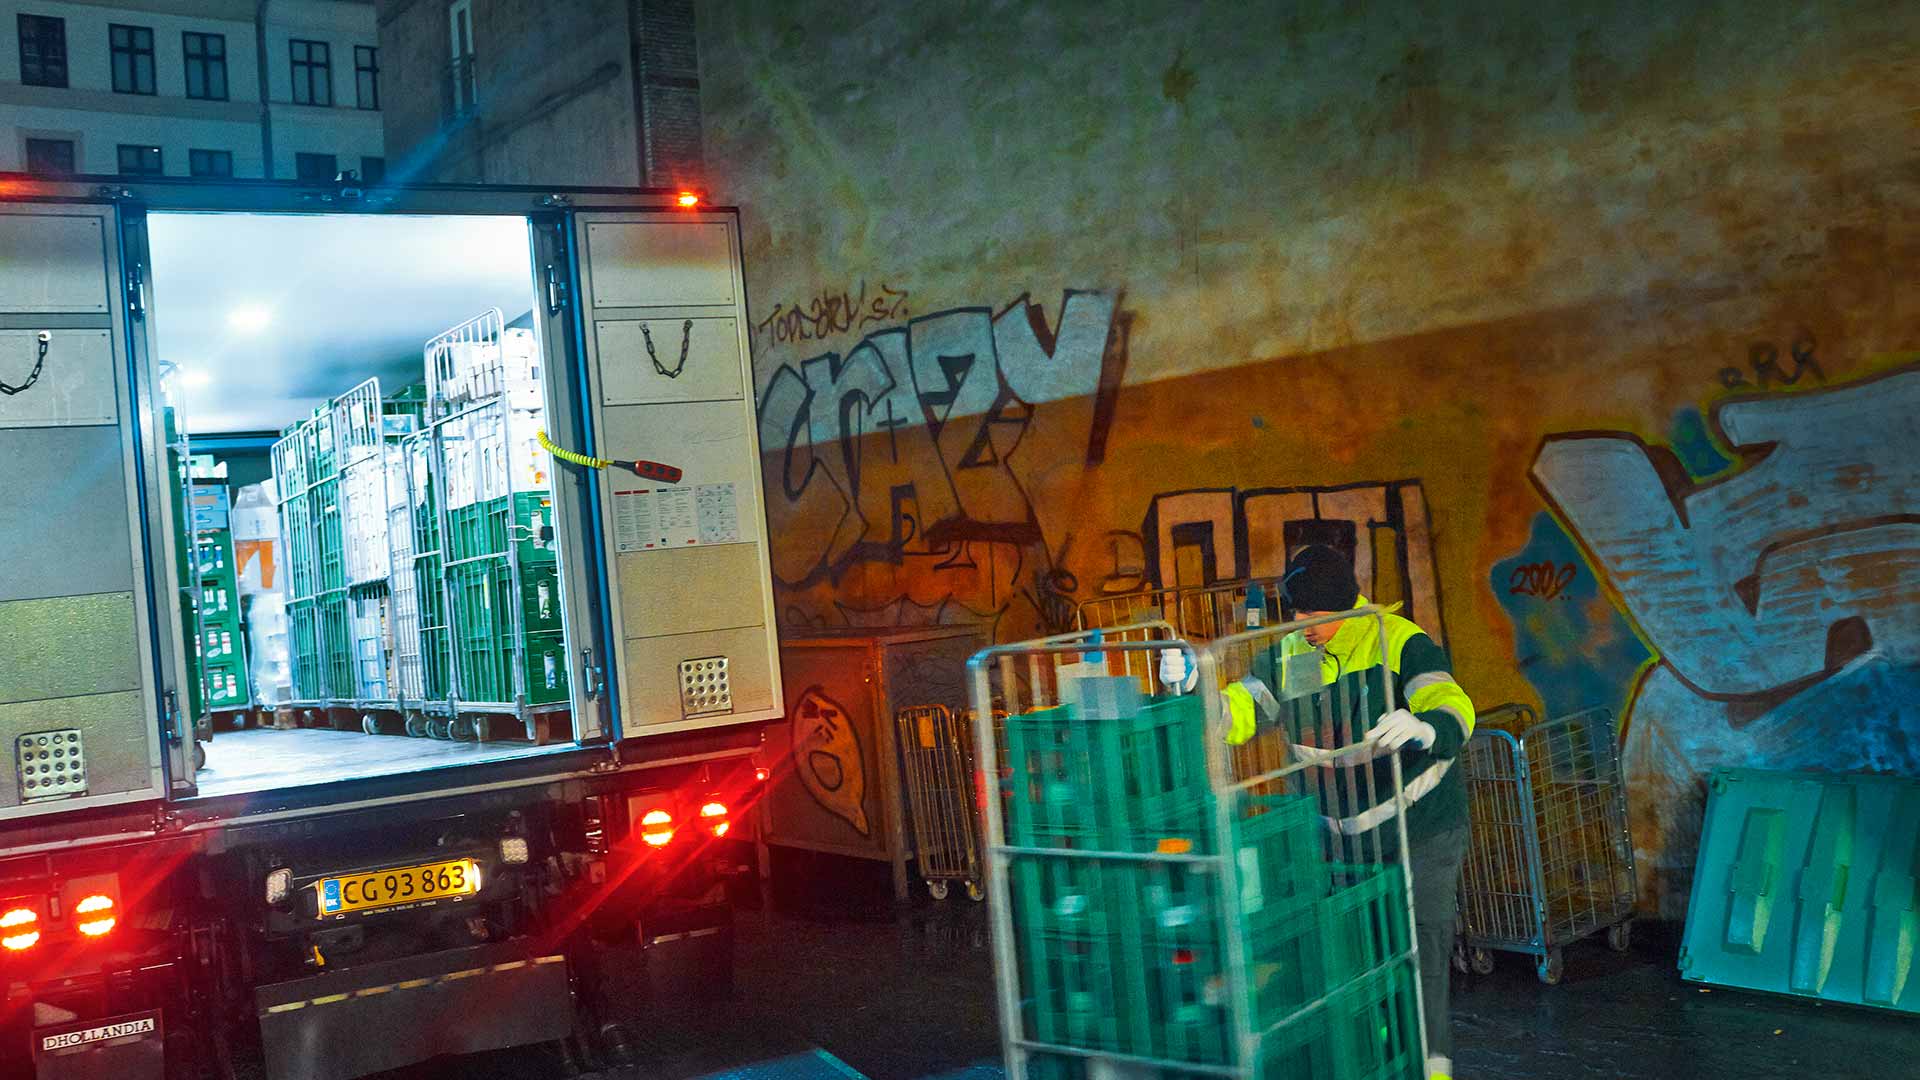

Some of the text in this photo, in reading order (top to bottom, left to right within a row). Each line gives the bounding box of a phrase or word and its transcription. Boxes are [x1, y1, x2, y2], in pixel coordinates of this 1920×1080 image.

[342, 865, 466, 904] CG 93 863
[326, 898, 338, 906] DK
[46, 1021, 151, 1049] DHOLLANDIA
